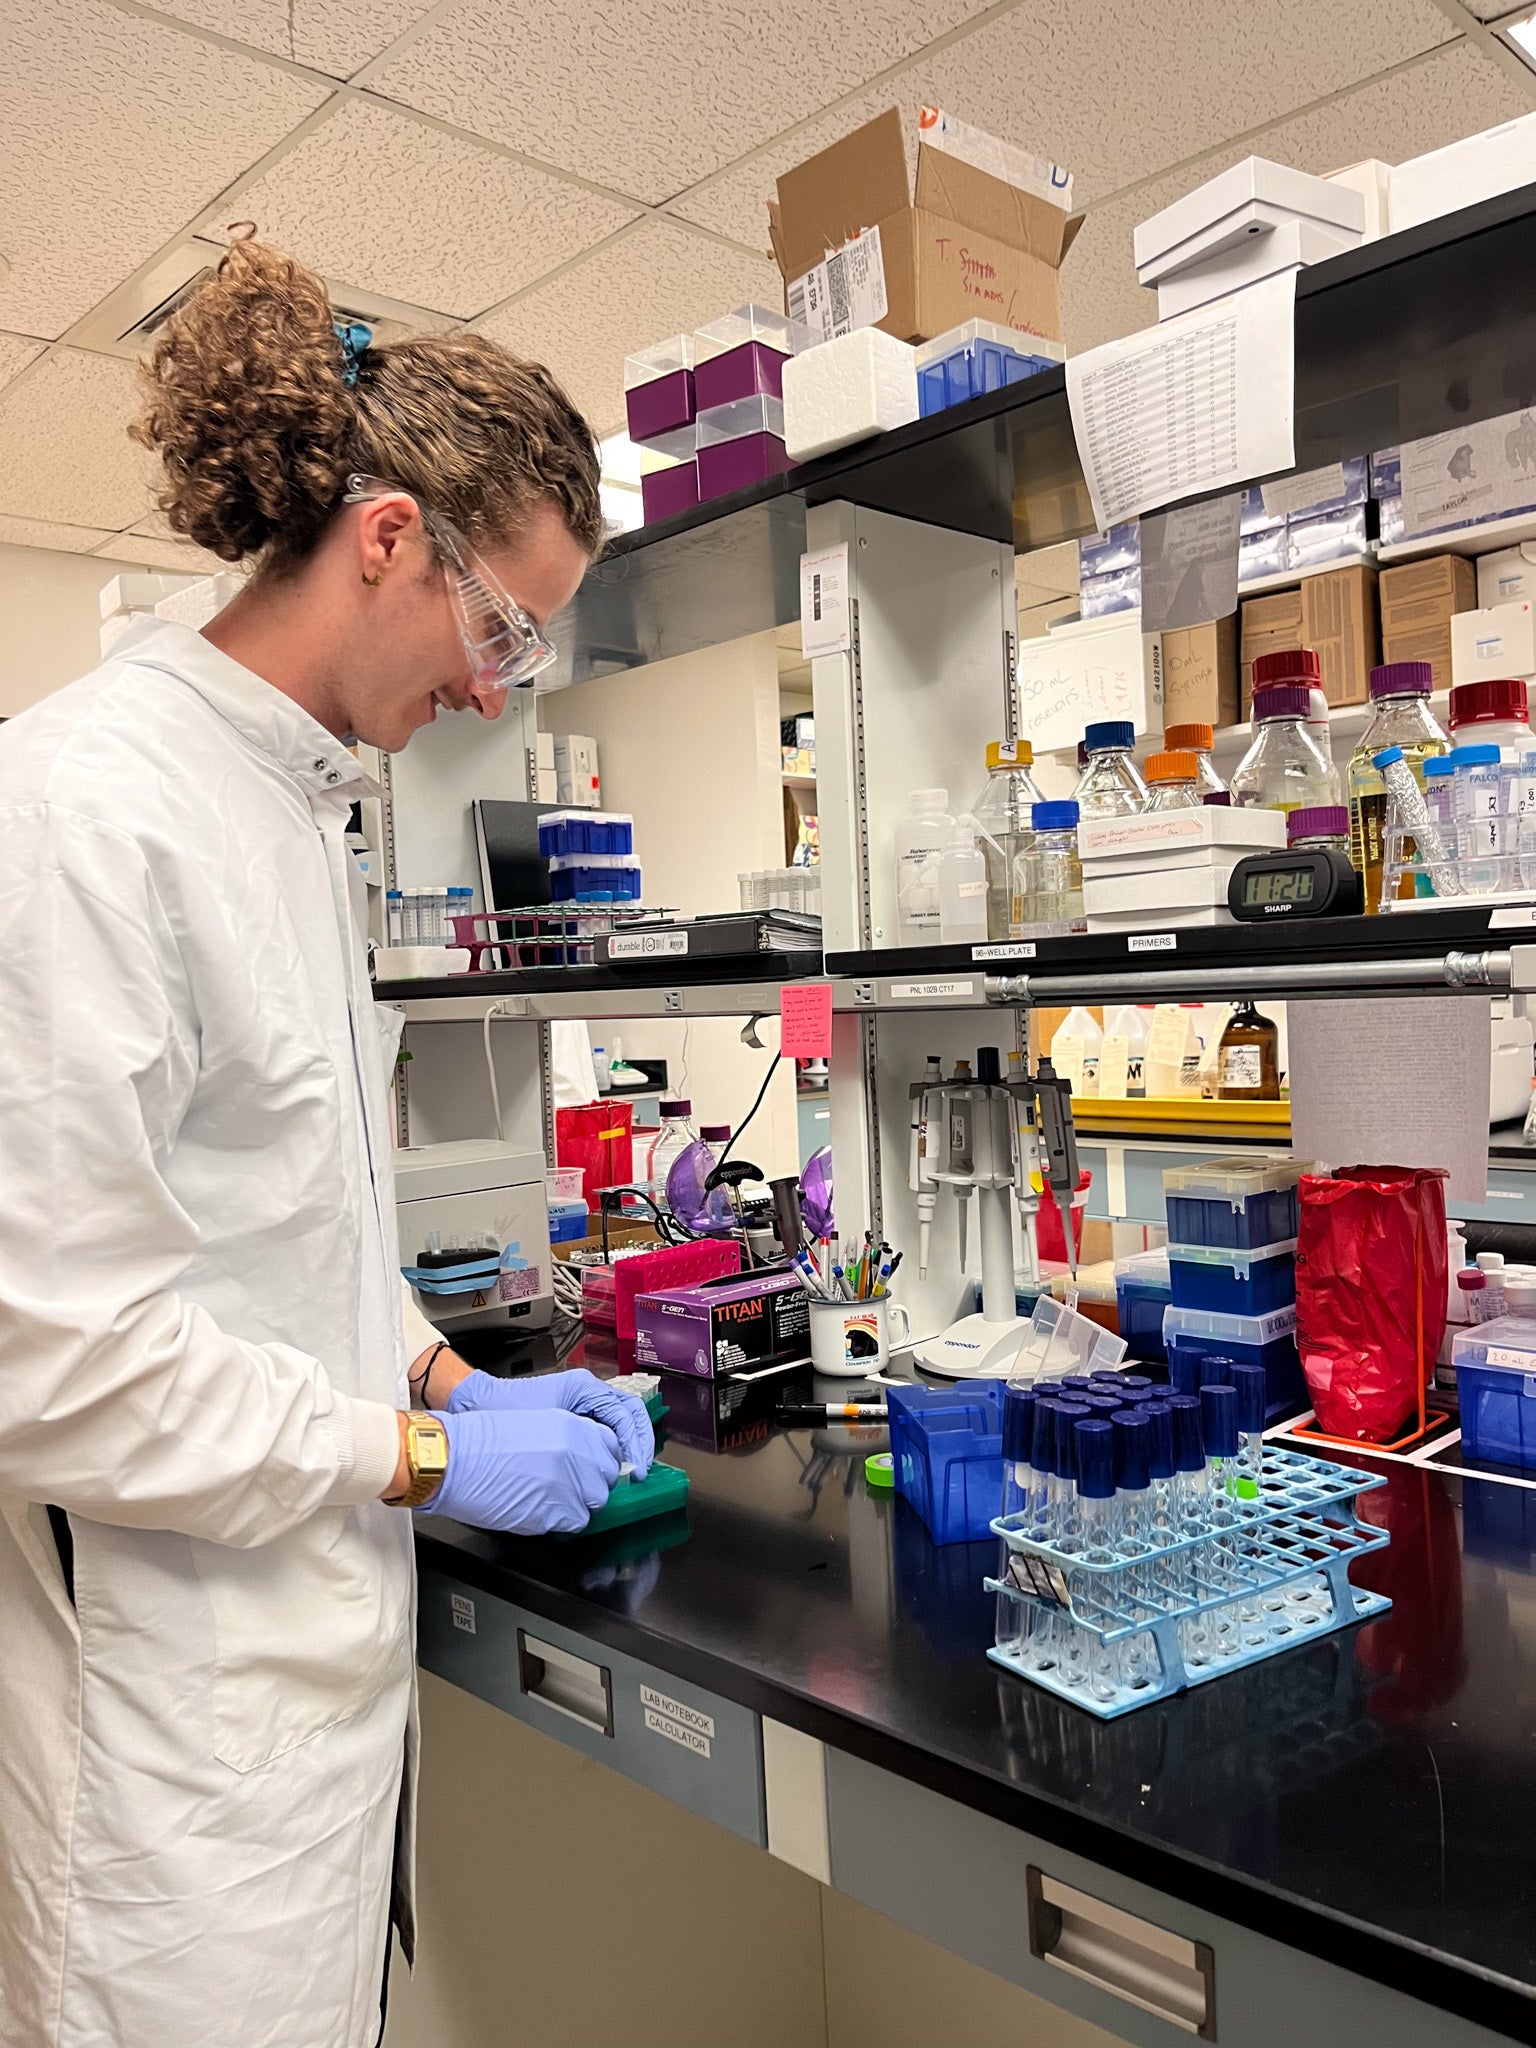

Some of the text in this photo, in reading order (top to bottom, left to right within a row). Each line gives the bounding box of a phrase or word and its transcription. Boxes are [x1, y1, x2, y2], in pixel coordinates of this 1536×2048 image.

[1469, 774, 1499, 784] FALCO
[1253, 871, 1312, 901] 11:20
[1264, 904, 1292, 913] SHARP
[1132, 938, 1172, 948] PRIMERS
[975, 946, 1032, 958] 96-WELL PLATE
[910, 986, 921, 994] PNL
[720, 1166, 753, 1179] eppendorf
[637, 1299, 657, 1310] TITAN
[713, 1297, 763, 1322] TITAN
[456, 1614, 472, 1630] TAPE
[644, 1690, 710, 1732] LAB NOTEBOOK
[649, 1714, 706, 1752] CALCULATOR
